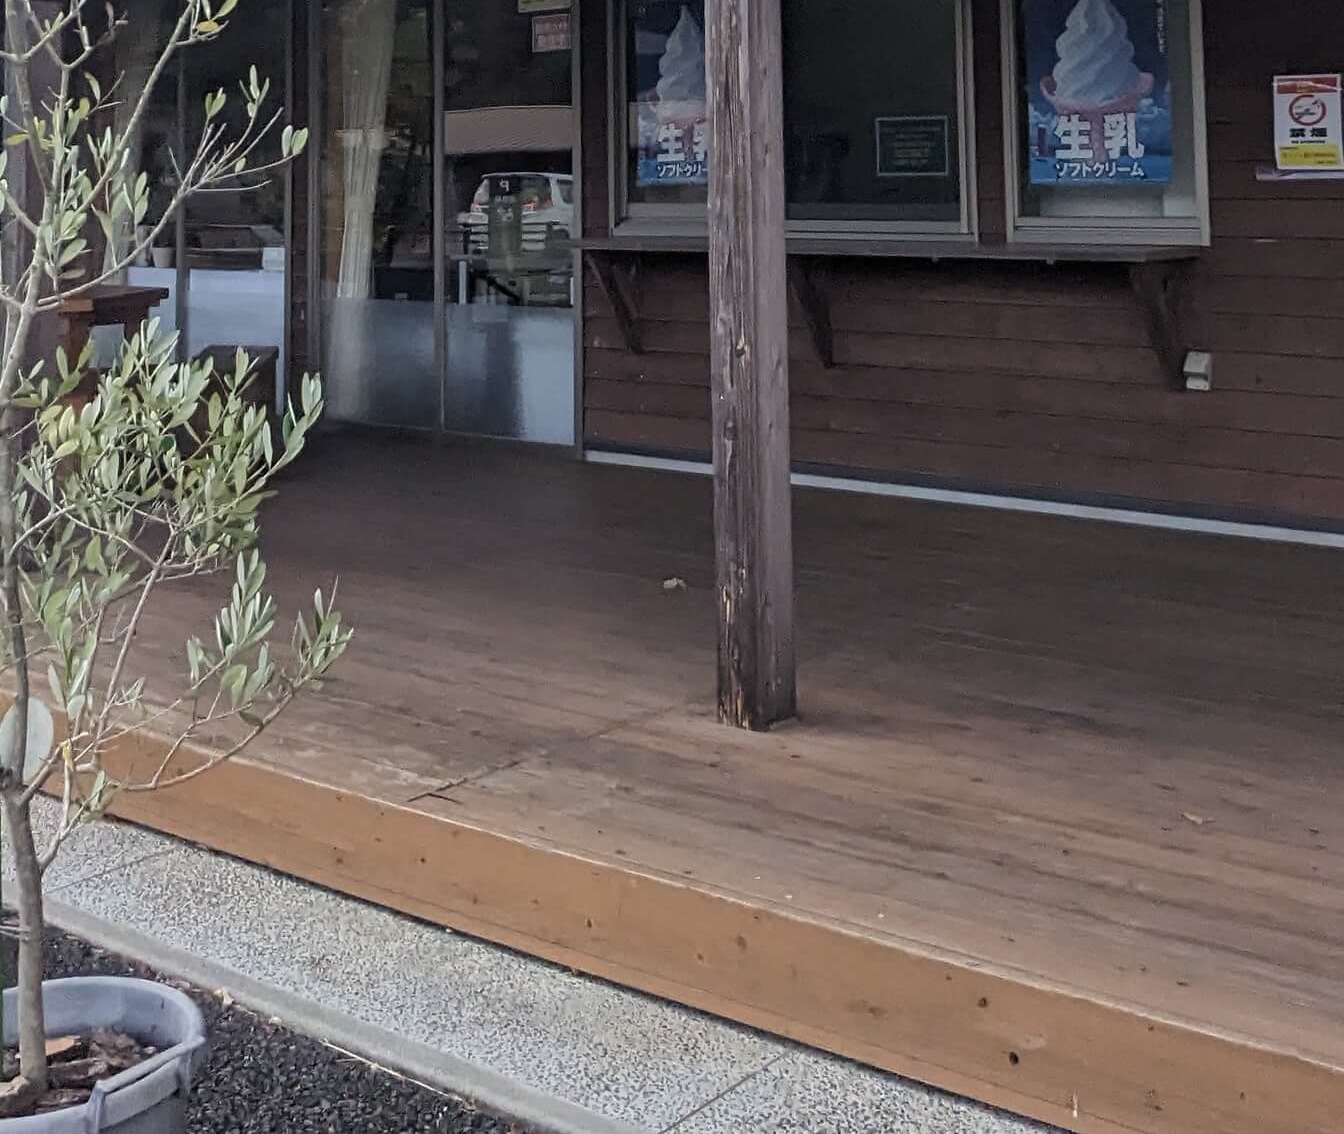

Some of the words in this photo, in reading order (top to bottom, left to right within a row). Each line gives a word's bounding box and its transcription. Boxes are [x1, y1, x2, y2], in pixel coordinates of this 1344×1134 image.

[1054, 112, 1145, 160] 生乳
[656, 164, 708, 178] ソフトクリ
[1056, 161, 1145, 178] ソフトクリーム
